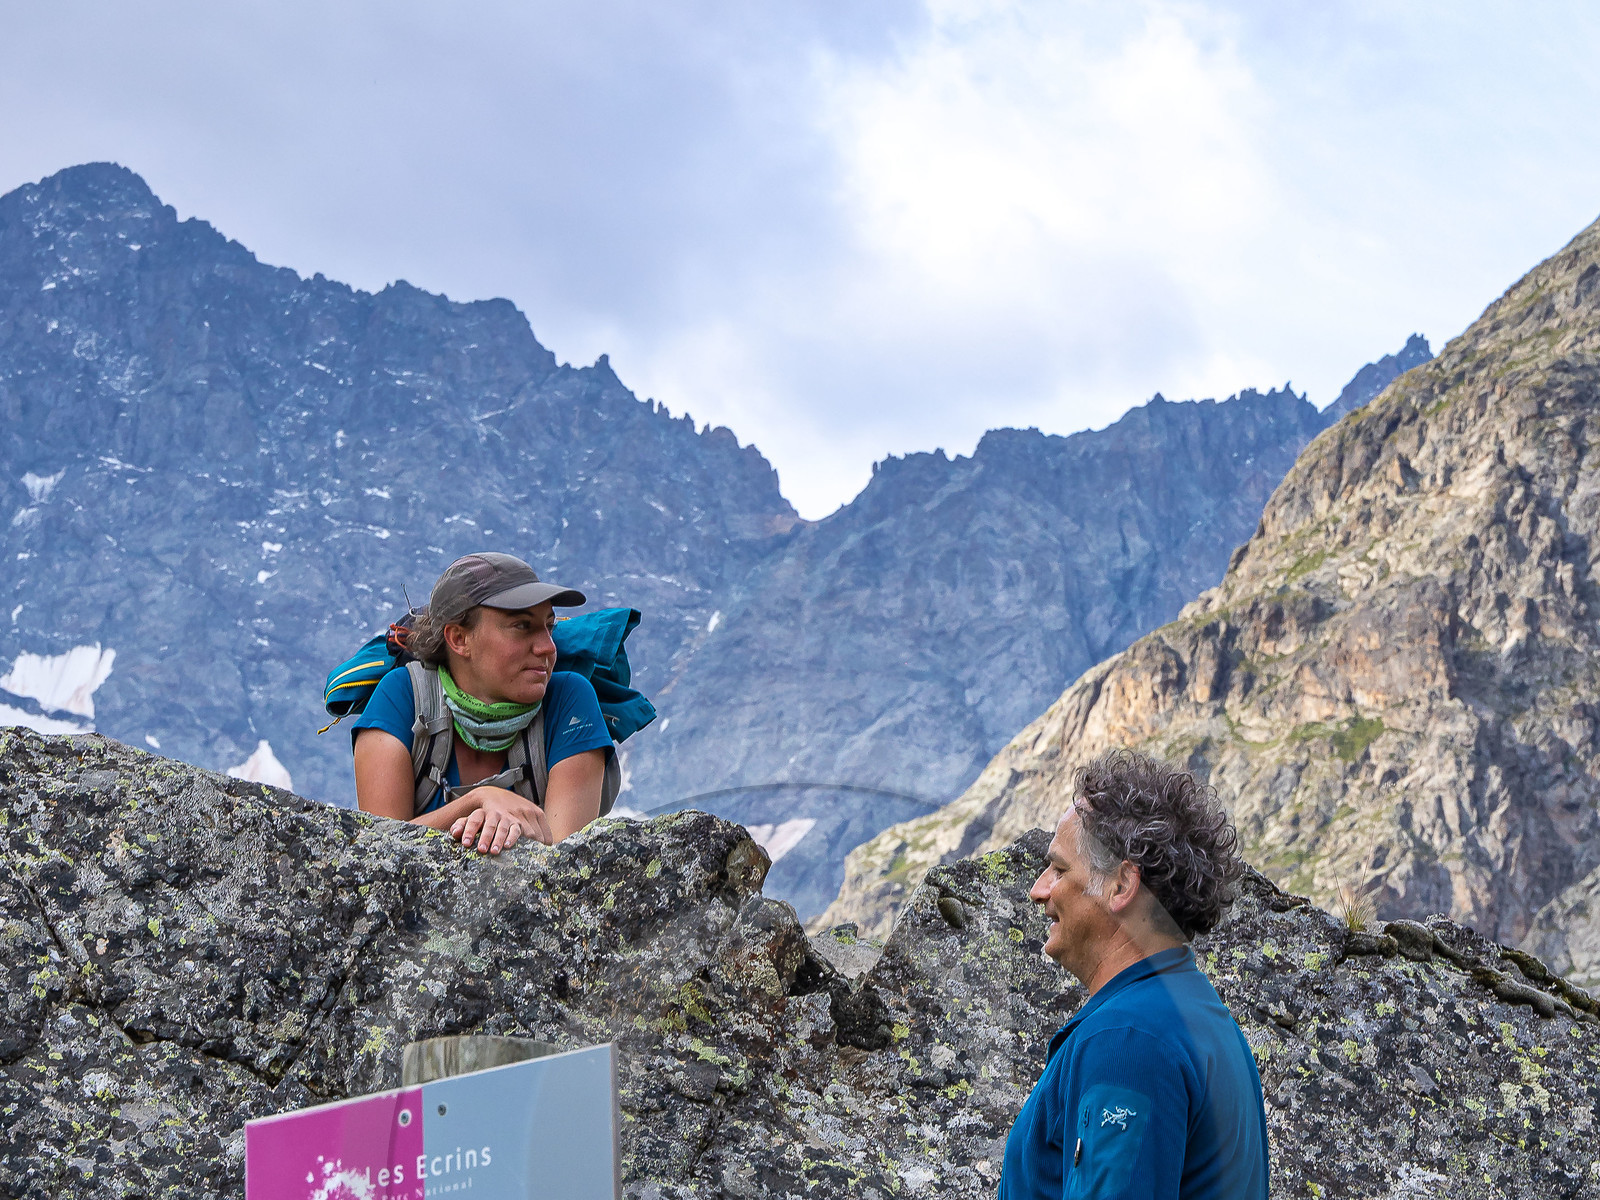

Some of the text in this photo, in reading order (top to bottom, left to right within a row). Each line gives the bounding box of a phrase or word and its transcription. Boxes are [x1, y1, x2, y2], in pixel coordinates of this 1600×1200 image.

[365, 1146, 492, 1188] Les Ecrins
[415, 1176, 473, 1199] National
